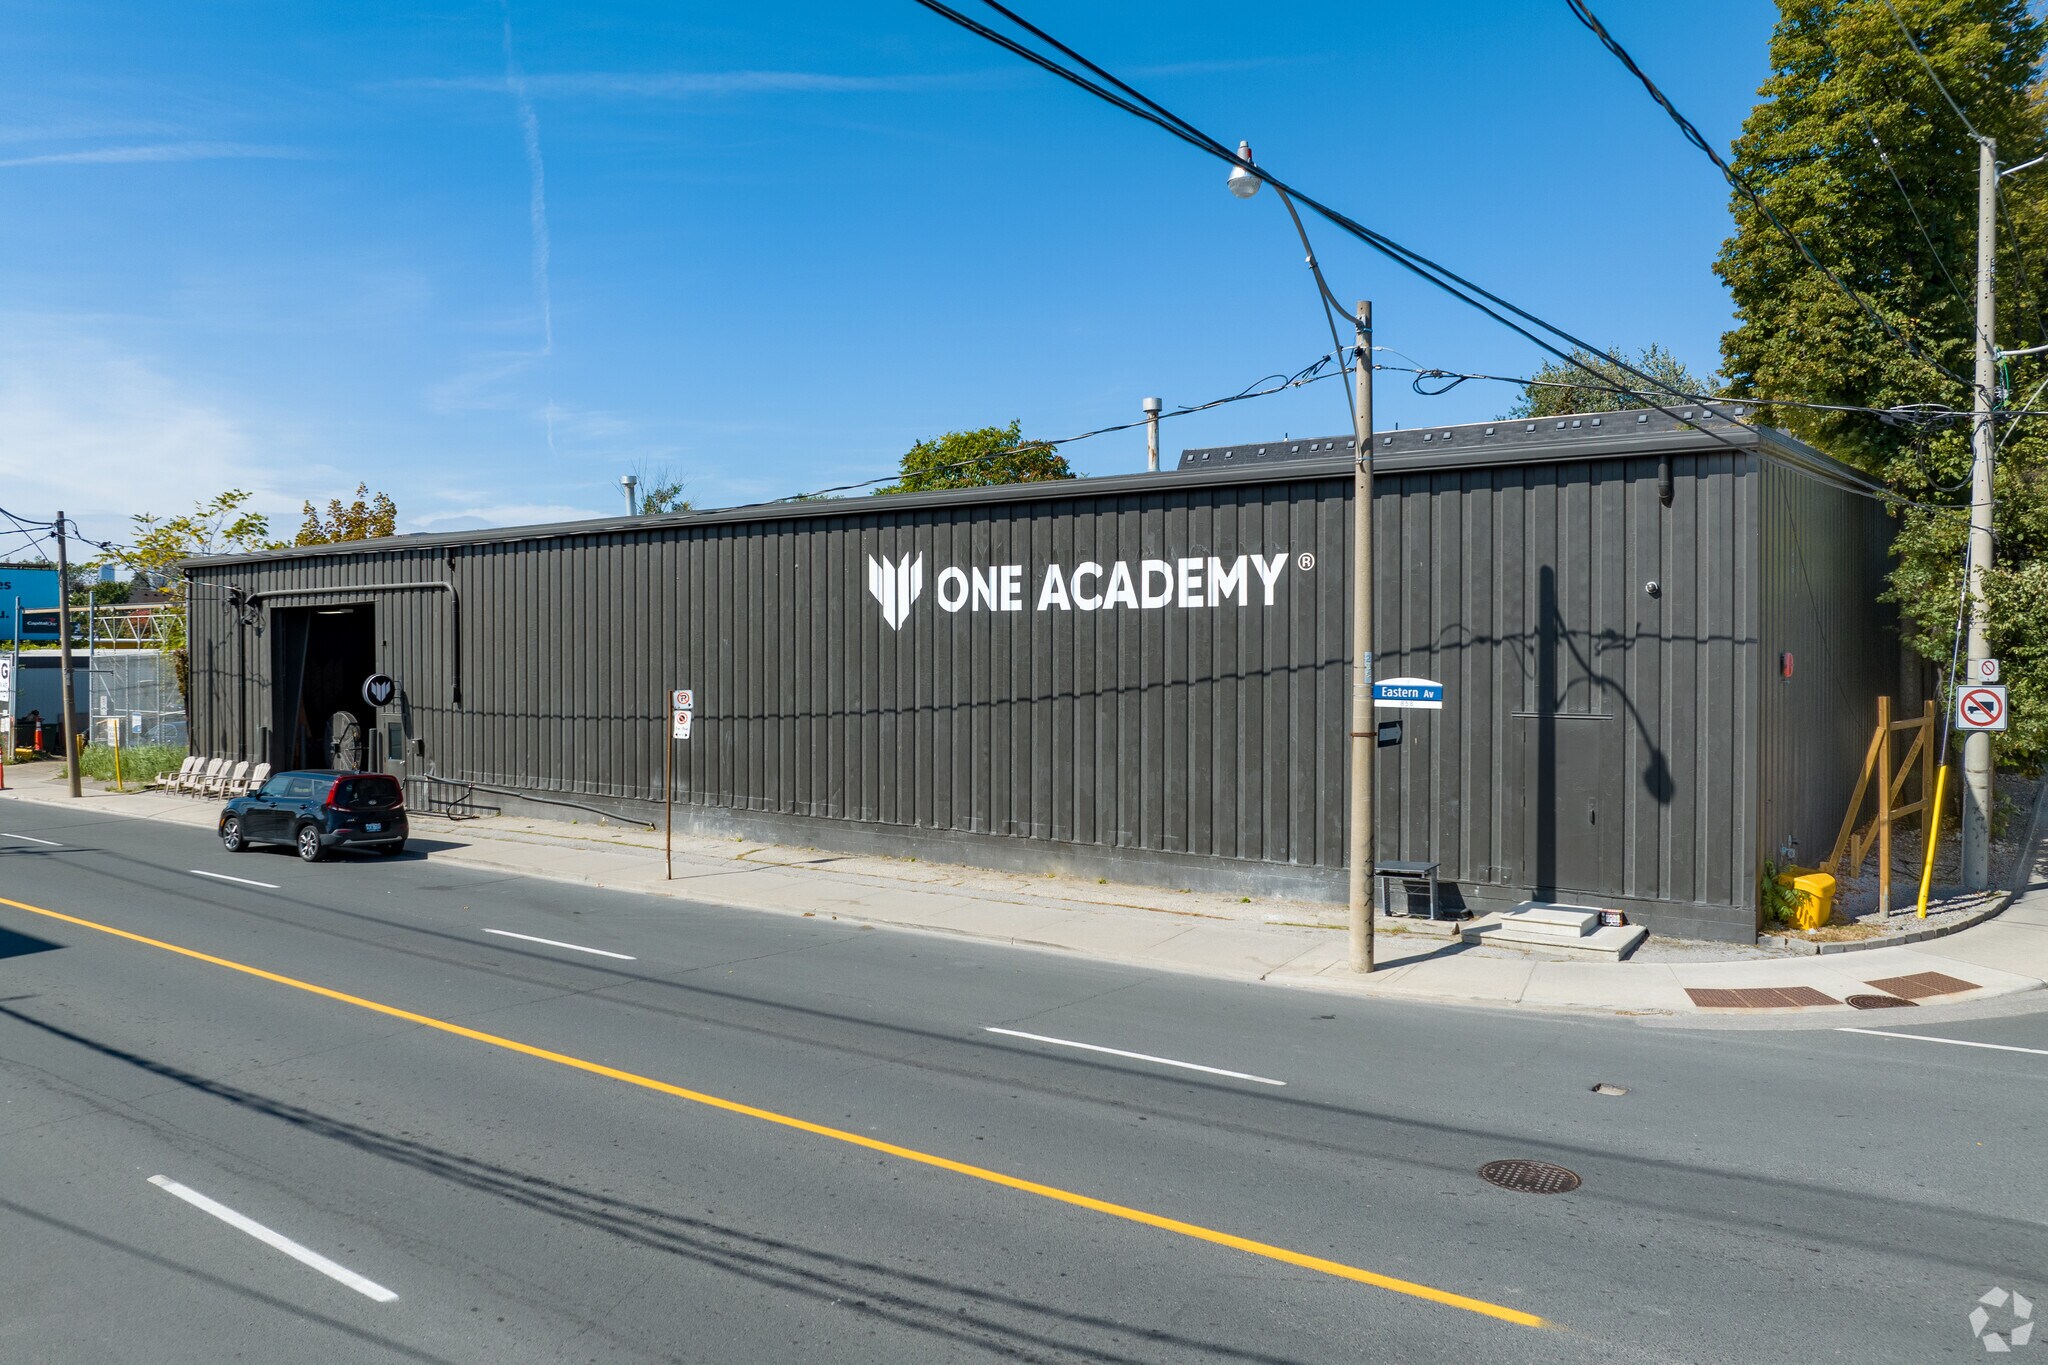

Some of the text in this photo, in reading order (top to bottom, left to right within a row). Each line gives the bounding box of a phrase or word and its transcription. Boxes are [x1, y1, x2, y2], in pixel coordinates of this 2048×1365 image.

[938, 564, 1022, 613] ONE
[1037, 553, 1289, 612] ACADEMY
[1381, 686, 1434, 698] Eastern Av
